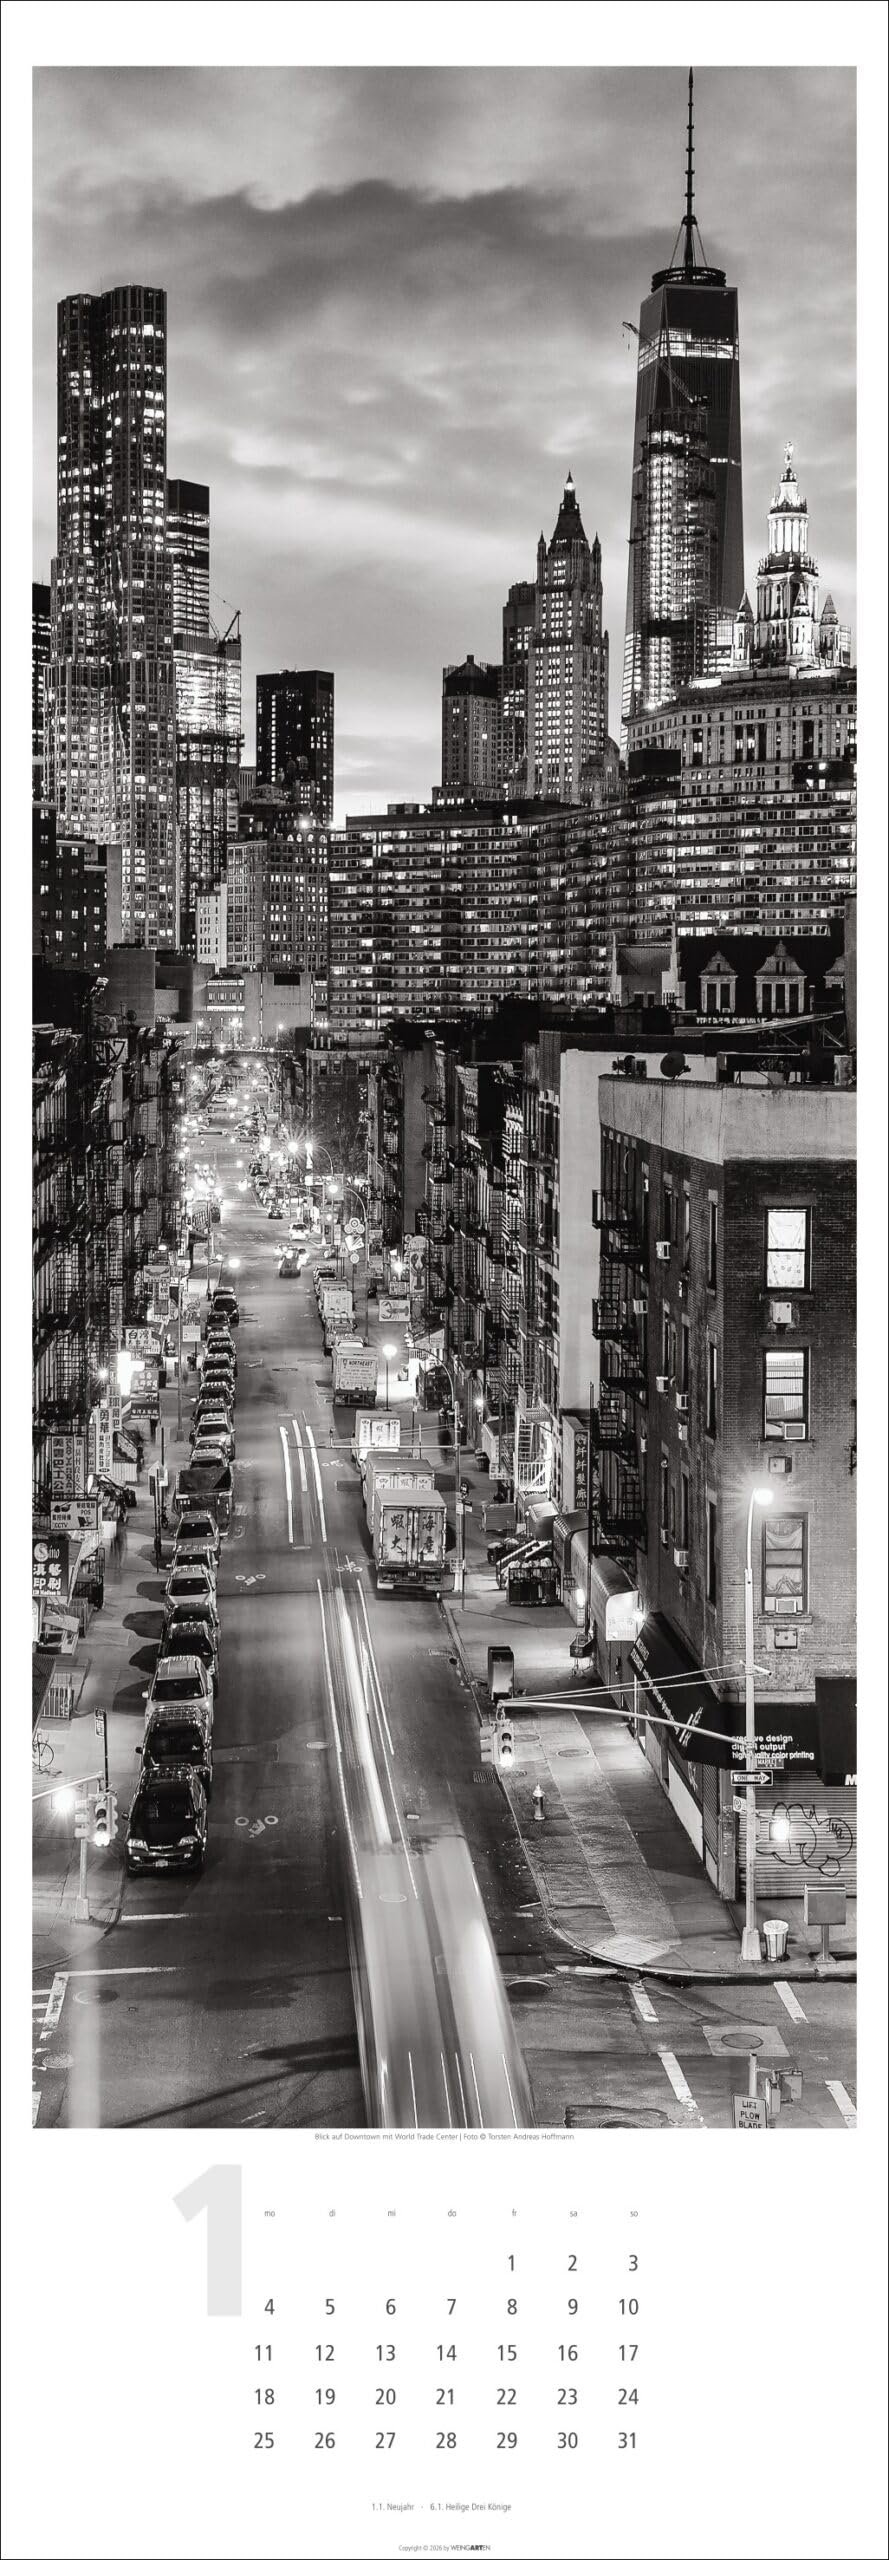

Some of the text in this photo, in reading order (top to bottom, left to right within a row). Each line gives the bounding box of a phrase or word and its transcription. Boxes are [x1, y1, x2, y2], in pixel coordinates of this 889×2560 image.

[765, 1734, 793, 1744] design
[759, 1742, 786, 1752] output
[771, 1751, 789, 1759] color
[789, 1751, 815, 1761] printing
[742, 2100, 757, 2110] LIFT
[740, 2110, 760, 2121] PLOW
